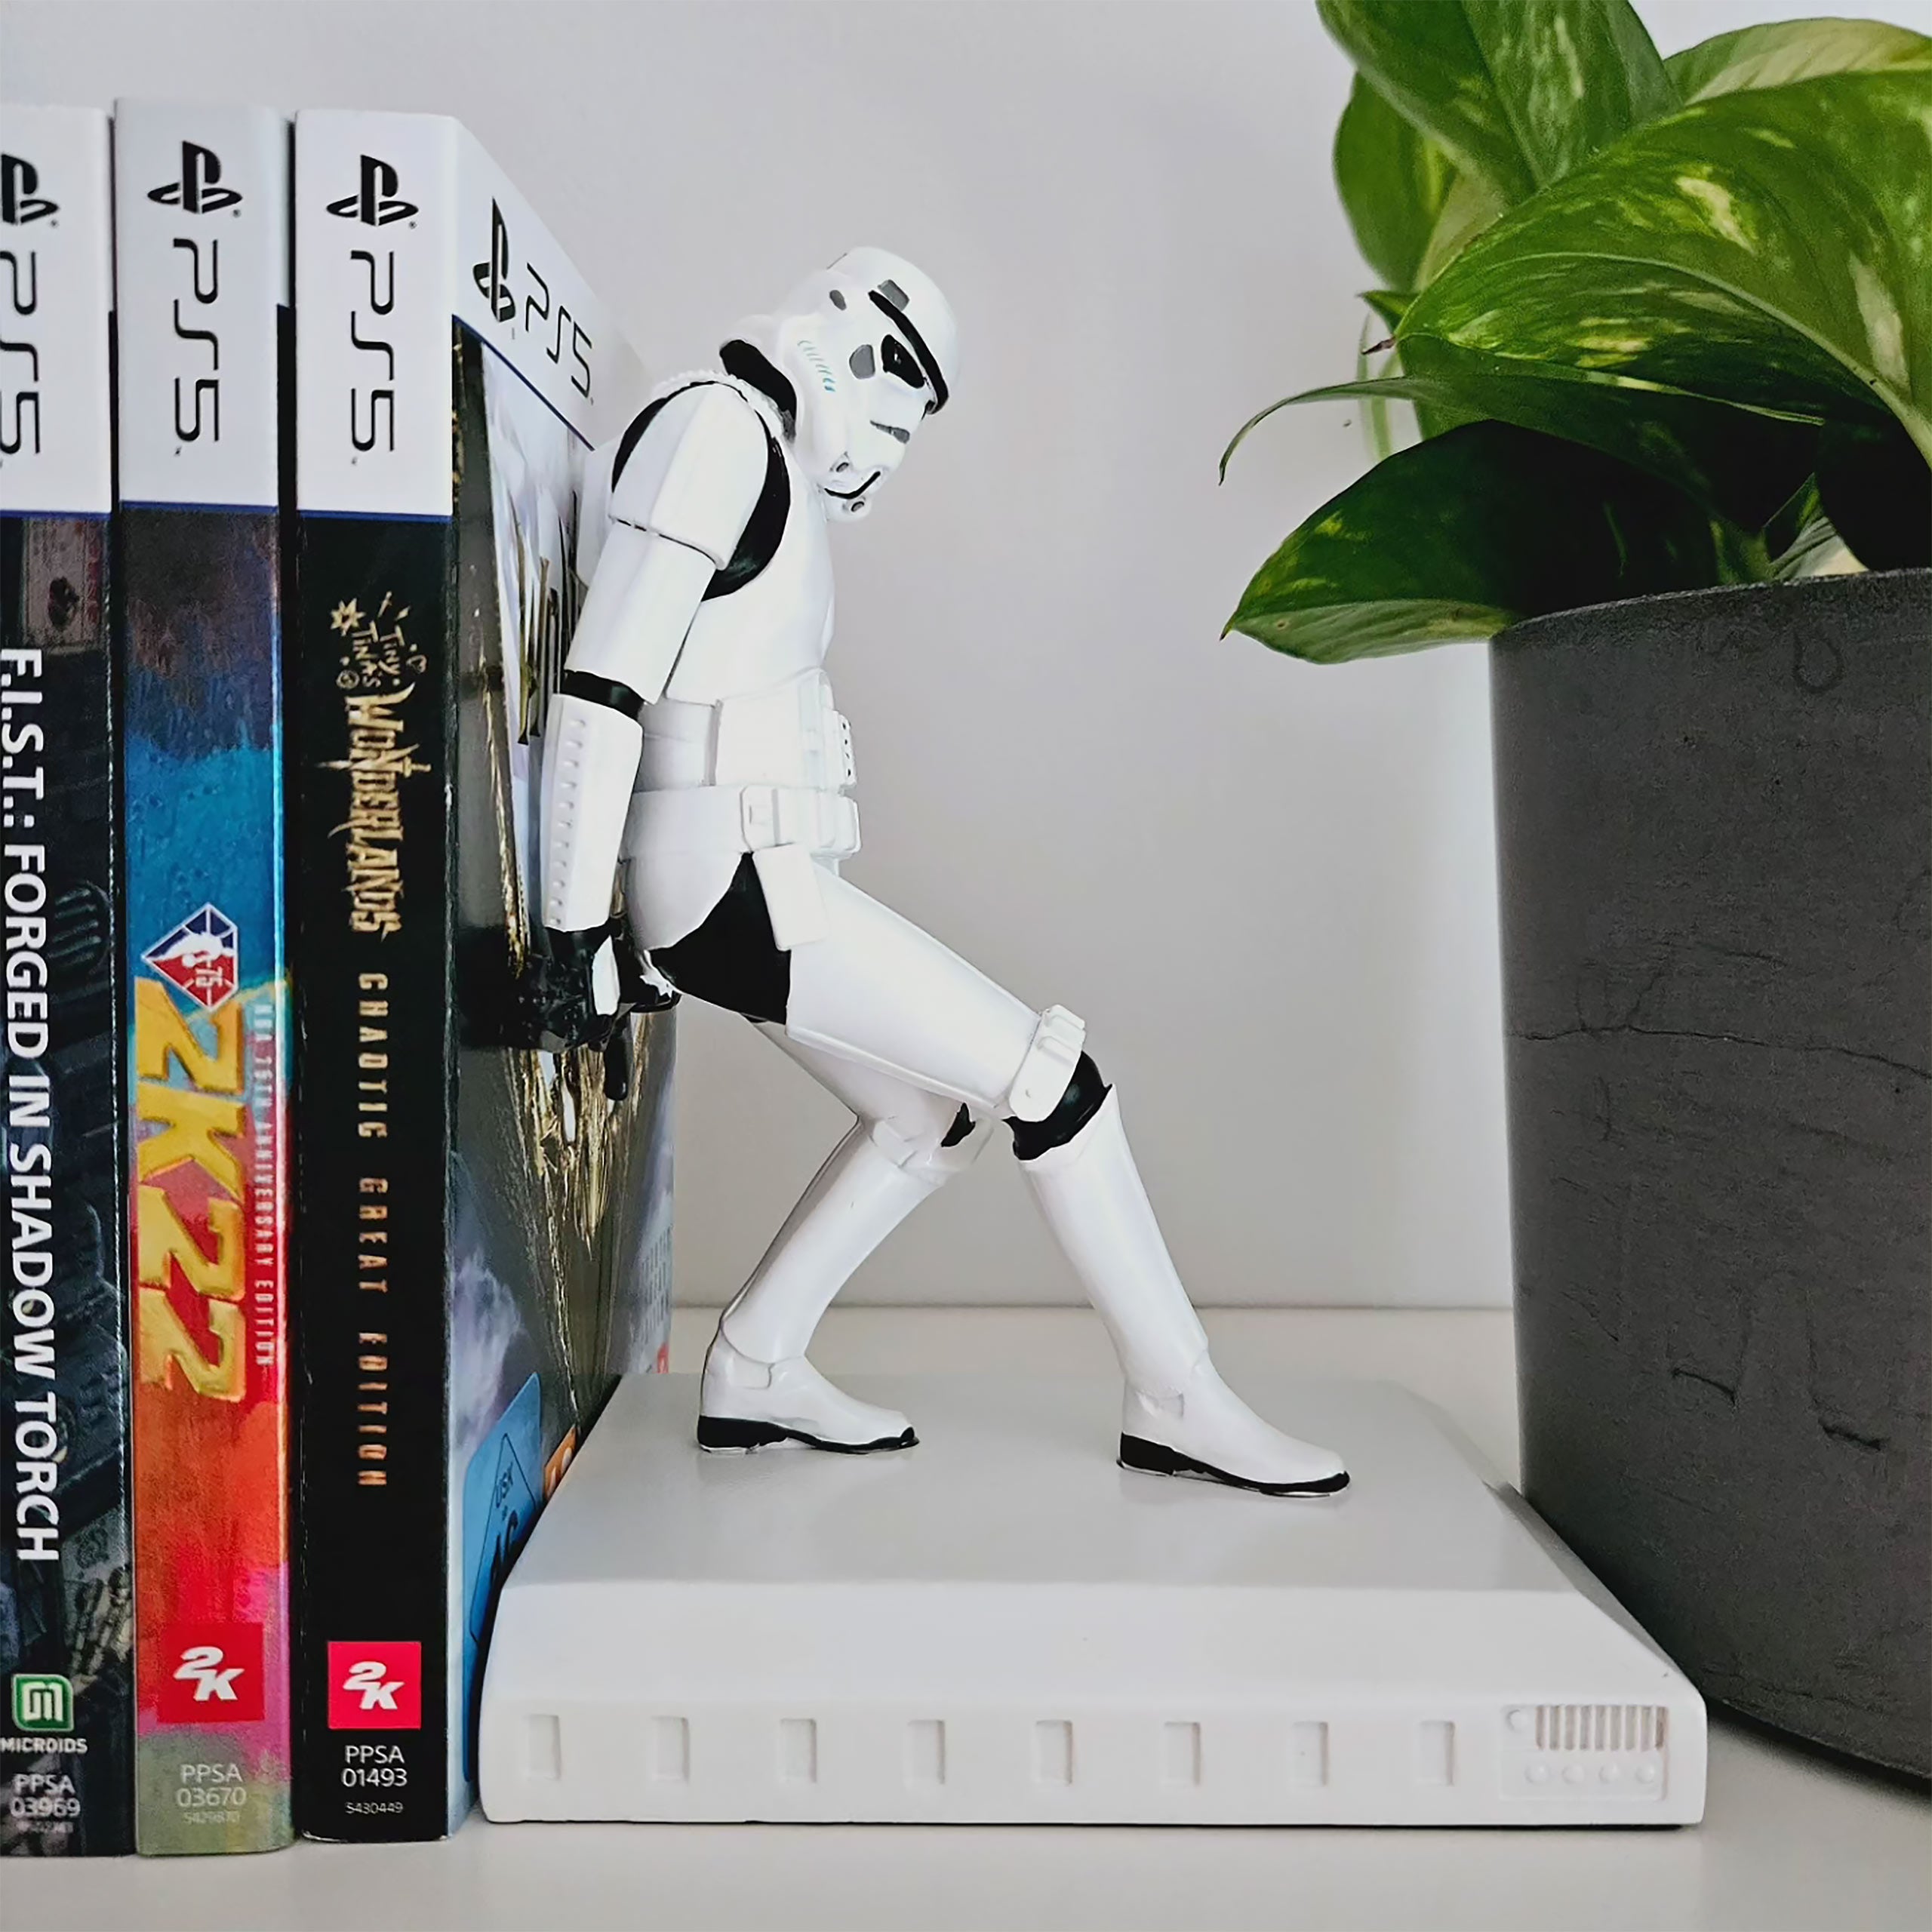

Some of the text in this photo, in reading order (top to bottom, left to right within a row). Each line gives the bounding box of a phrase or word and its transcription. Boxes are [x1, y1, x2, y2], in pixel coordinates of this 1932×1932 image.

[0, 251, 41, 454] PS5
[173, 238, 220, 442] PS5
[350, 250, 394, 452] PS5
[525, 263, 592, 398] PS5
[332, 682, 423, 940] WONDERLANDS
[0, 648, 59, 1561] F.I.S.T.: FORGED IN SHADOW TORCH
[134, 977, 246, 1403] 2K22
[254, 1121, 274, 1266] ANNIVERSARY
[358, 972, 389, 1486] CHAOTIC GREAT EDITION
[254, 1279, 275, 1366] EDITION
[173, 1645, 245, 1702] 2K
[343, 1661, 405, 1710] 2K
[0, 1737, 88, 1755] MICROIDS
[14, 1774, 75, 1795] PPSA
[181, 1764, 243, 1784] PPSA
[341, 1767, 408, 1787] 01493
[345, 1744, 405, 1764] PPSA
[11, 1796, 81, 1818] 03969
[177, 1786, 248, 1807] 03670
